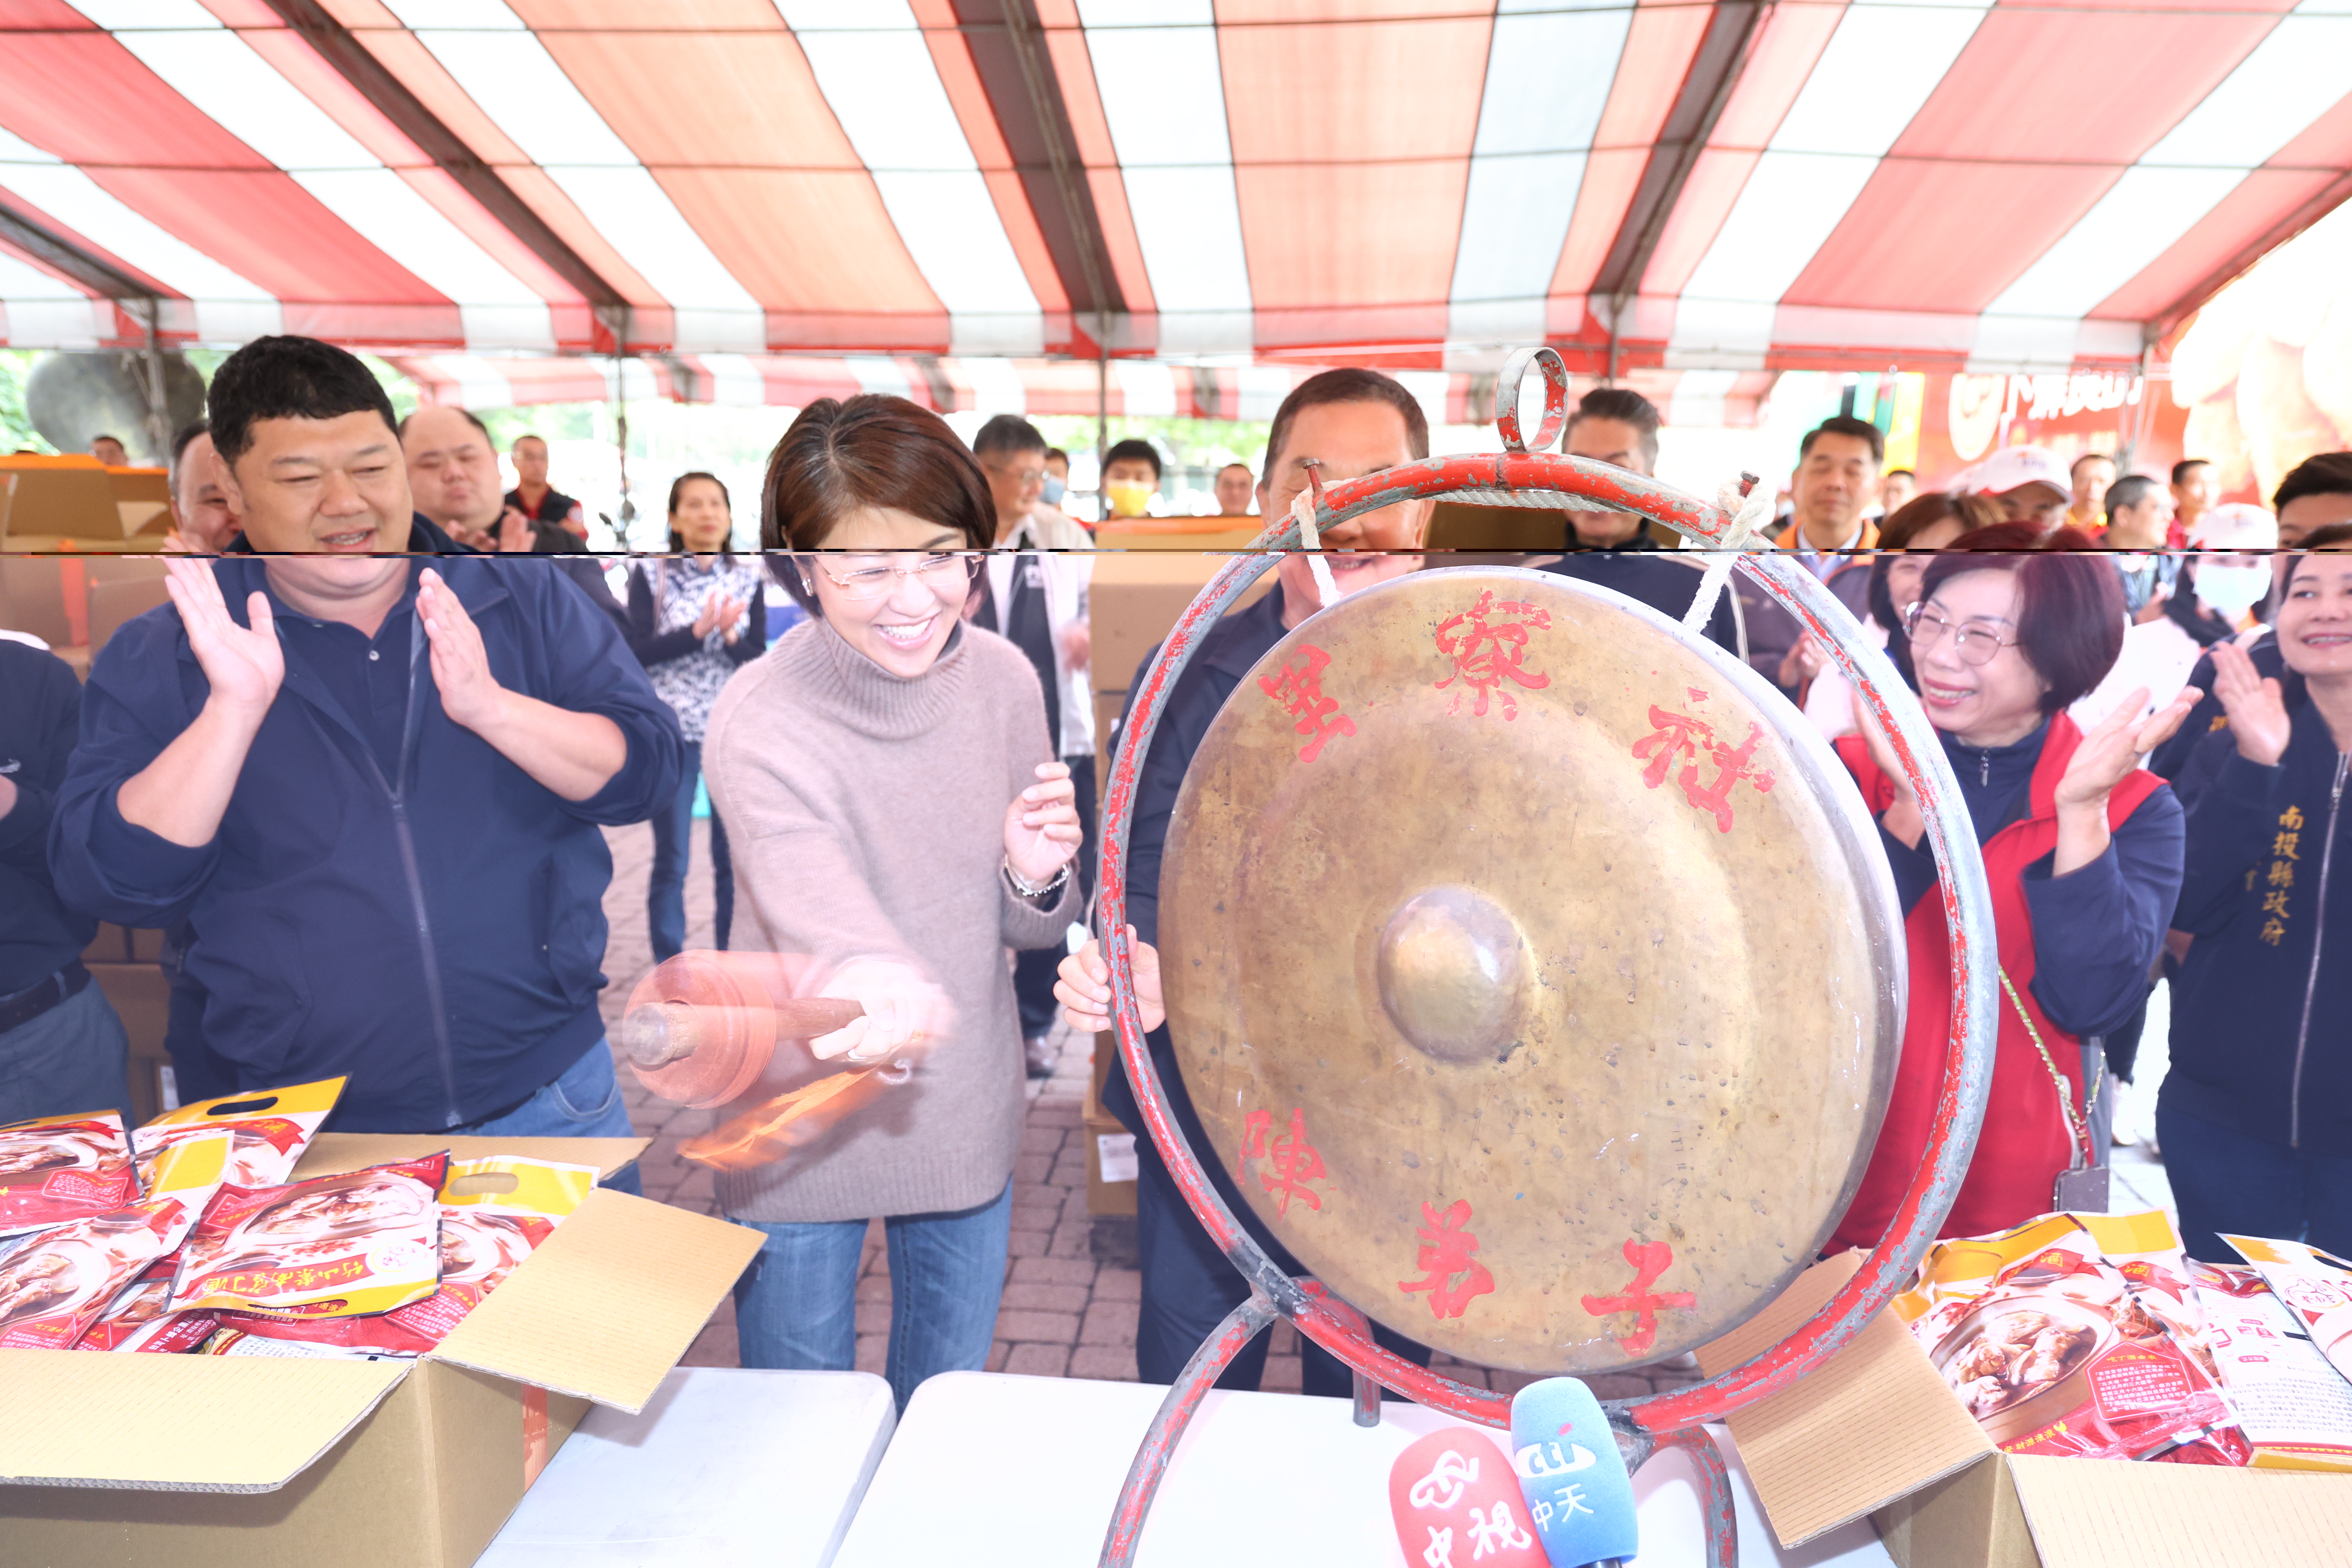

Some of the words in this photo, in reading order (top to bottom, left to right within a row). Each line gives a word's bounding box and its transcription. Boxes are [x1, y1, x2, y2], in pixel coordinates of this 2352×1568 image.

[2258, 804, 2306, 947] 南投縣政府
[2040, 1253, 2063, 1268] 酒
[2125, 1264, 2150, 1277] 酒
[202, 1261, 366, 1295] 竹山紫南宮丁酒
[2016, 1429, 2056, 1450] 財源滾滾
[1531, 1483, 1594, 1532] 中天
[1423, 1501, 1532, 1568] 中視
